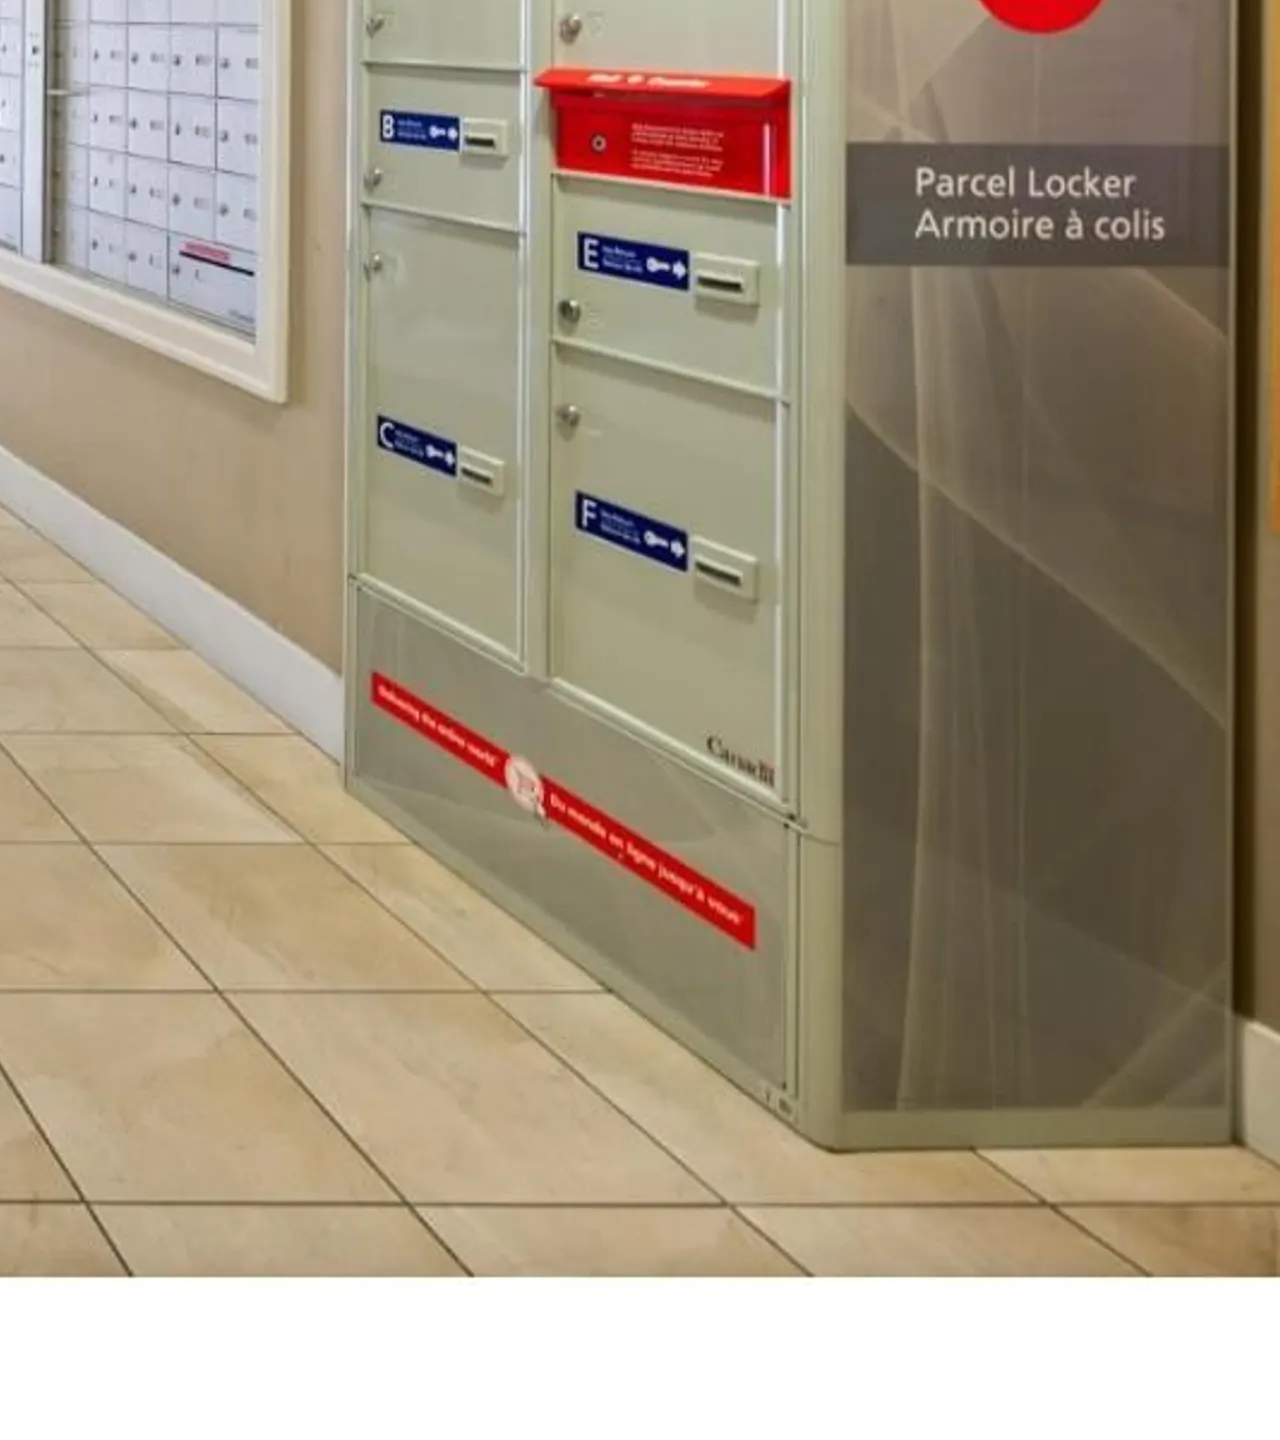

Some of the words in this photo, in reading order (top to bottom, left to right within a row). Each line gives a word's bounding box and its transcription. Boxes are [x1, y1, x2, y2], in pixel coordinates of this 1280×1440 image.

[382, 114, 395, 139] B
[915, 165, 1015, 198] Parcel
[1028, 165, 1137, 198] Locker
[914, 208, 1054, 240] Armoire
[1064, 208, 1084, 240] à
[1094, 208, 1166, 241] colis
[583, 237, 599, 270] E
[380, 421, 394, 449] C
[582, 498, 597, 528] F
